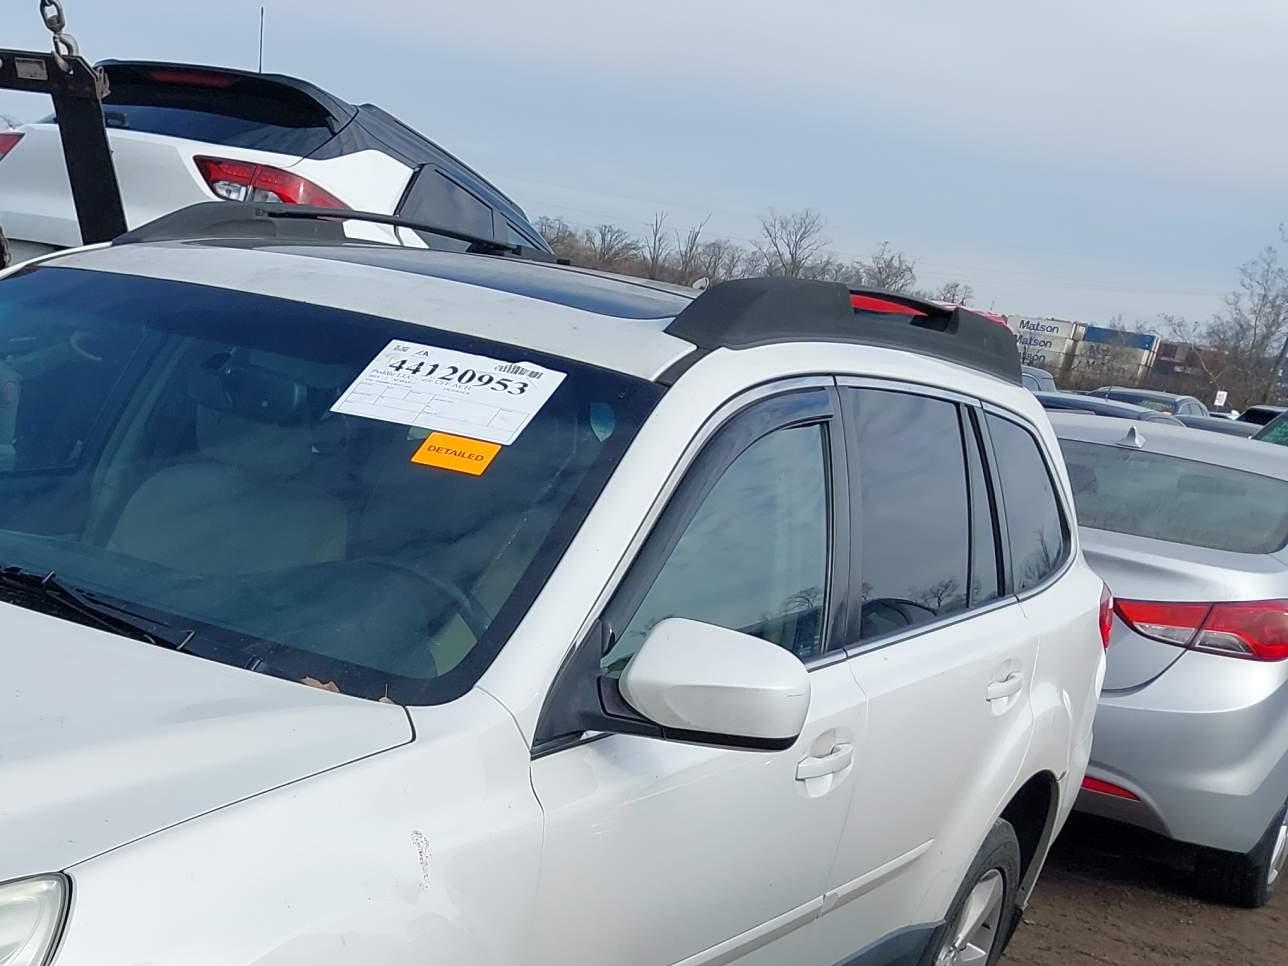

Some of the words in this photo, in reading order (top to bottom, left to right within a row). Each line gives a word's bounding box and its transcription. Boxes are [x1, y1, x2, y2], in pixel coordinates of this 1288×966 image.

[1019, 320, 1060, 334] Matson
[388, 359, 529, 395] 44120953
[427, 444, 484, 462] DETAILED
